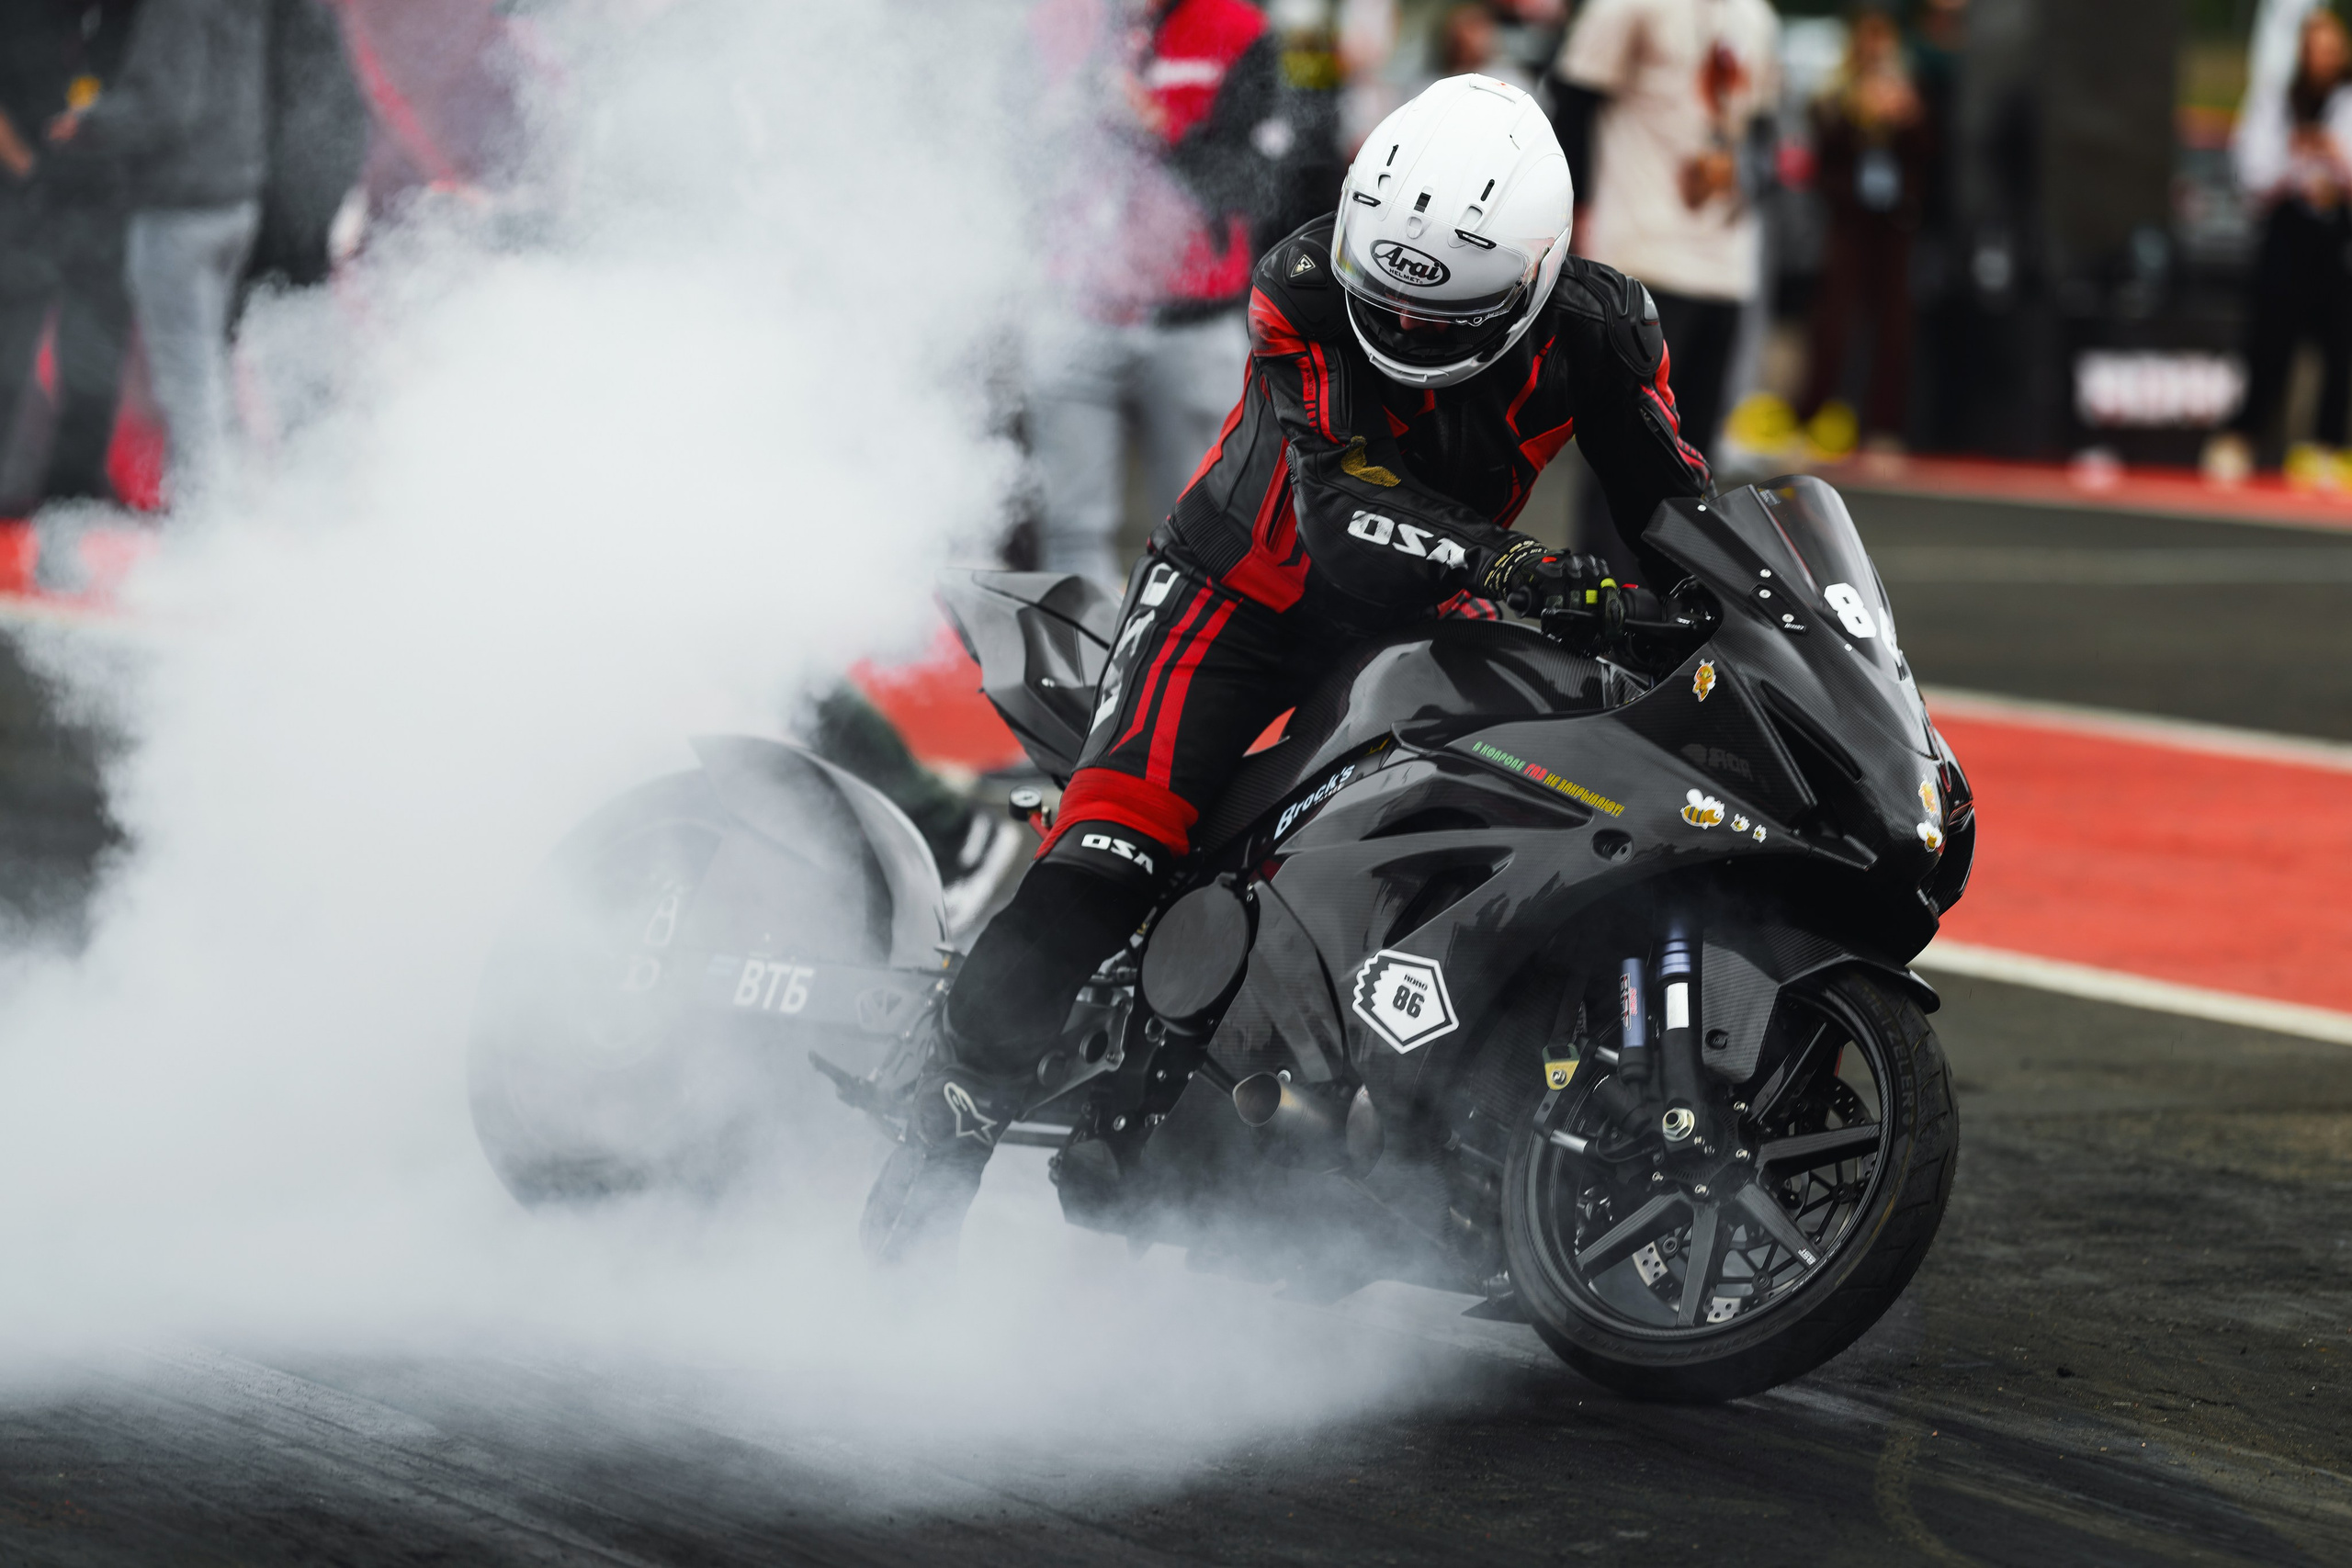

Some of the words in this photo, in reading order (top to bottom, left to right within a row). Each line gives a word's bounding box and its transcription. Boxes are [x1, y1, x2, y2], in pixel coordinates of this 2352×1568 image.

[1373, 246, 1441, 280] Arai
[1347, 510, 1468, 570] OSA
[1273, 764, 1355, 840] Brock's
[1081, 833, 1154, 875] OSA
[733, 959, 815, 1013] ВТБ
[1393, 985, 1425, 1019] 86
